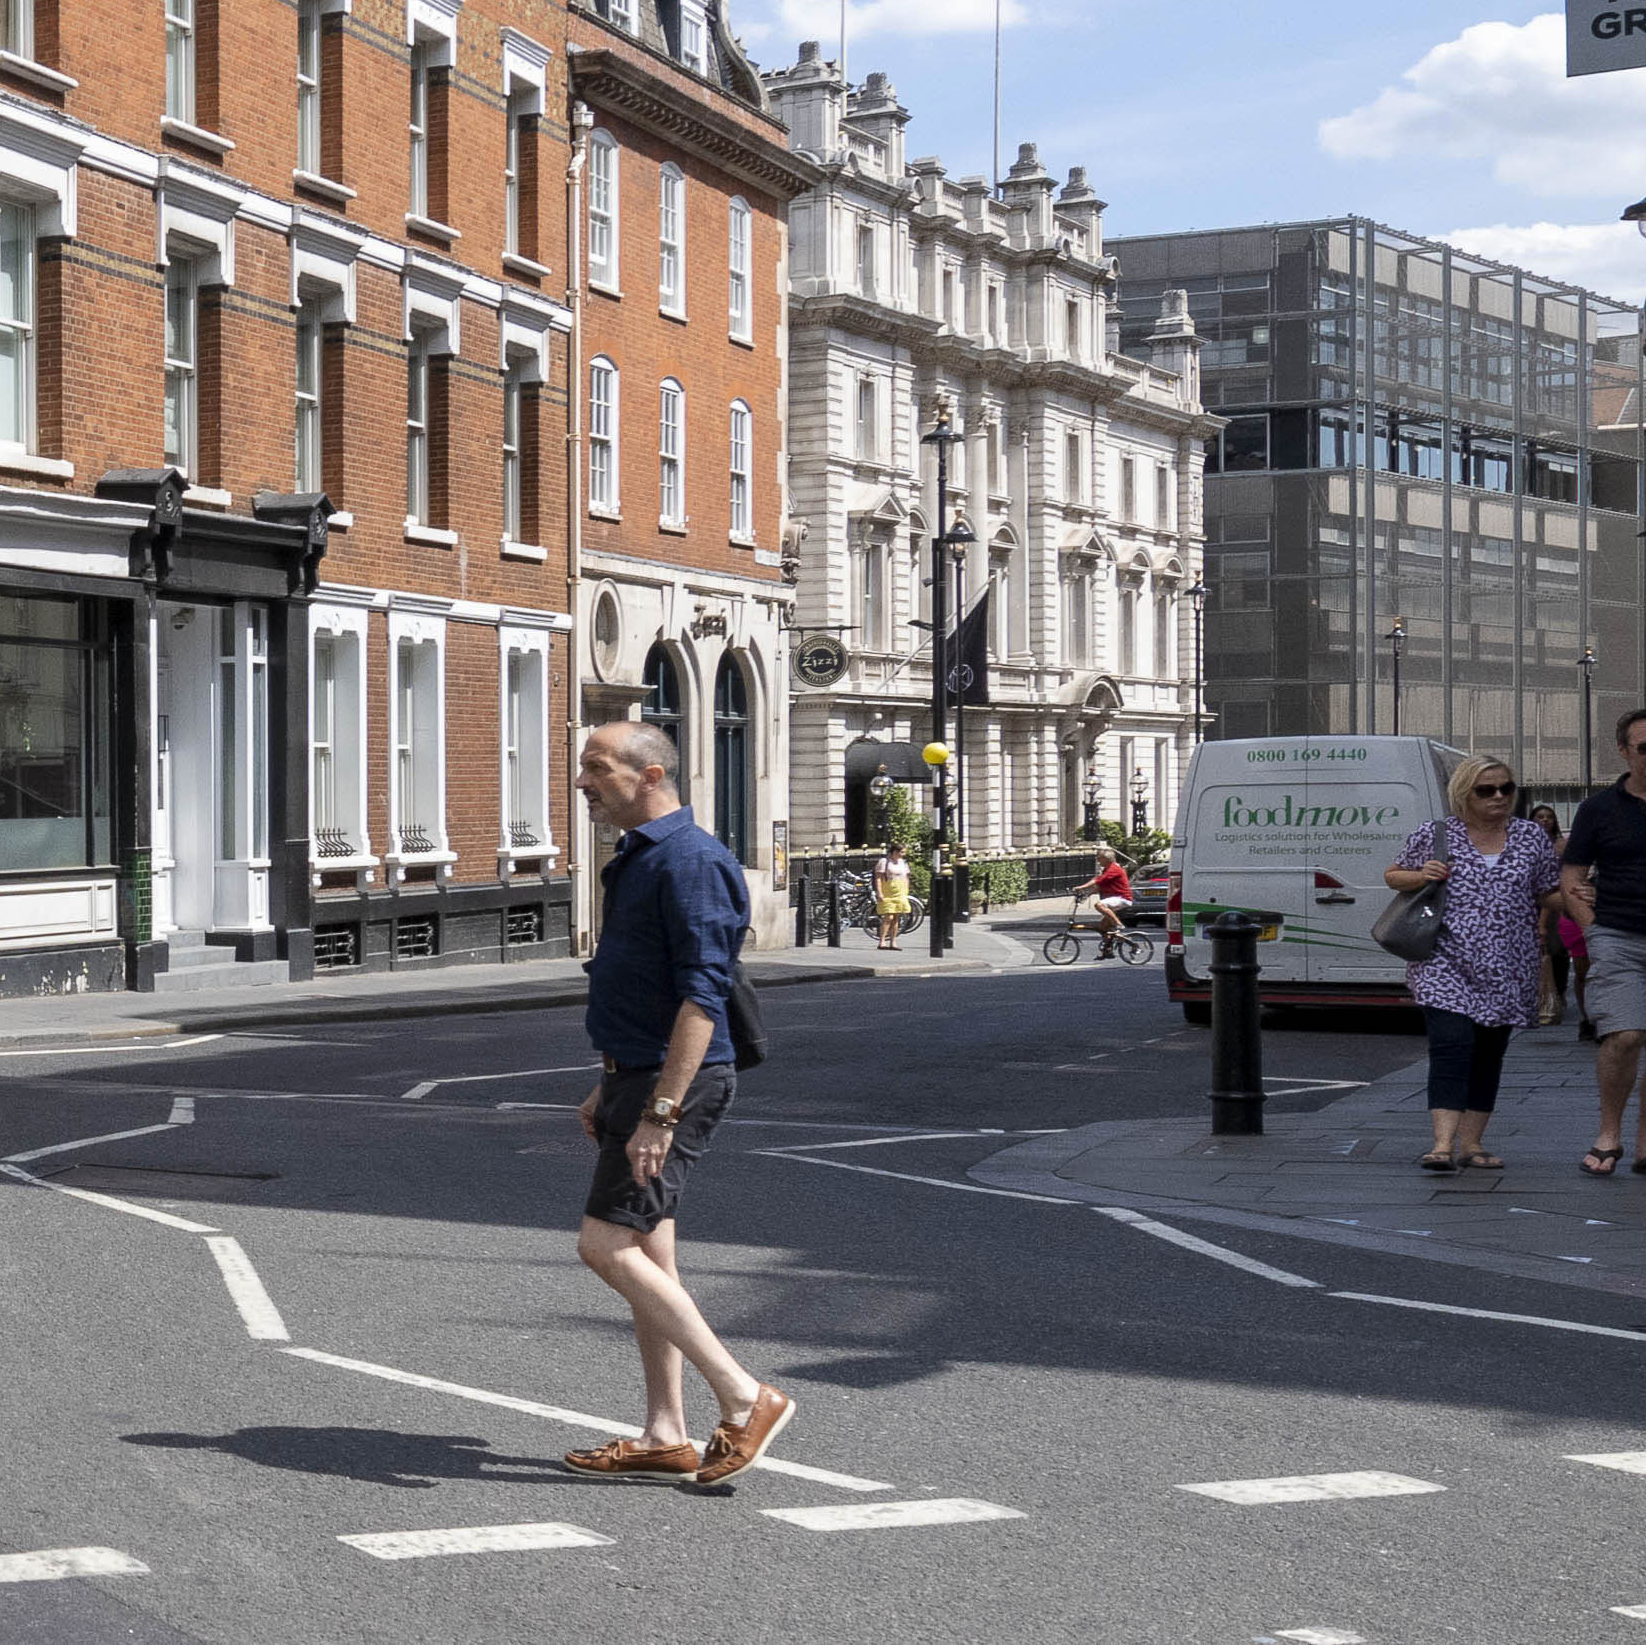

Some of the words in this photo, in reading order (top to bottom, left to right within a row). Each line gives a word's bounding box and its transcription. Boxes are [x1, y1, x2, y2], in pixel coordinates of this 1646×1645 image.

[802, 655, 838, 668] Zizzi
[1247, 749, 1286, 762] 0800
[1292, 749, 1320, 761] 169
[1327, 748, 1367, 761] 4440
[1223, 795, 1399, 827] foodmove
[1215, 832, 1263, 843] Logistics
[1265, 832, 1309, 842] solution
[1313, 831, 1329, 842] for
[1333, 831, 1403, 842] Wholesalers
[1249, 845, 1295, 855] Retailers
[1299, 845, 1317, 855] and
[1323, 845, 1372, 855] Caterers
